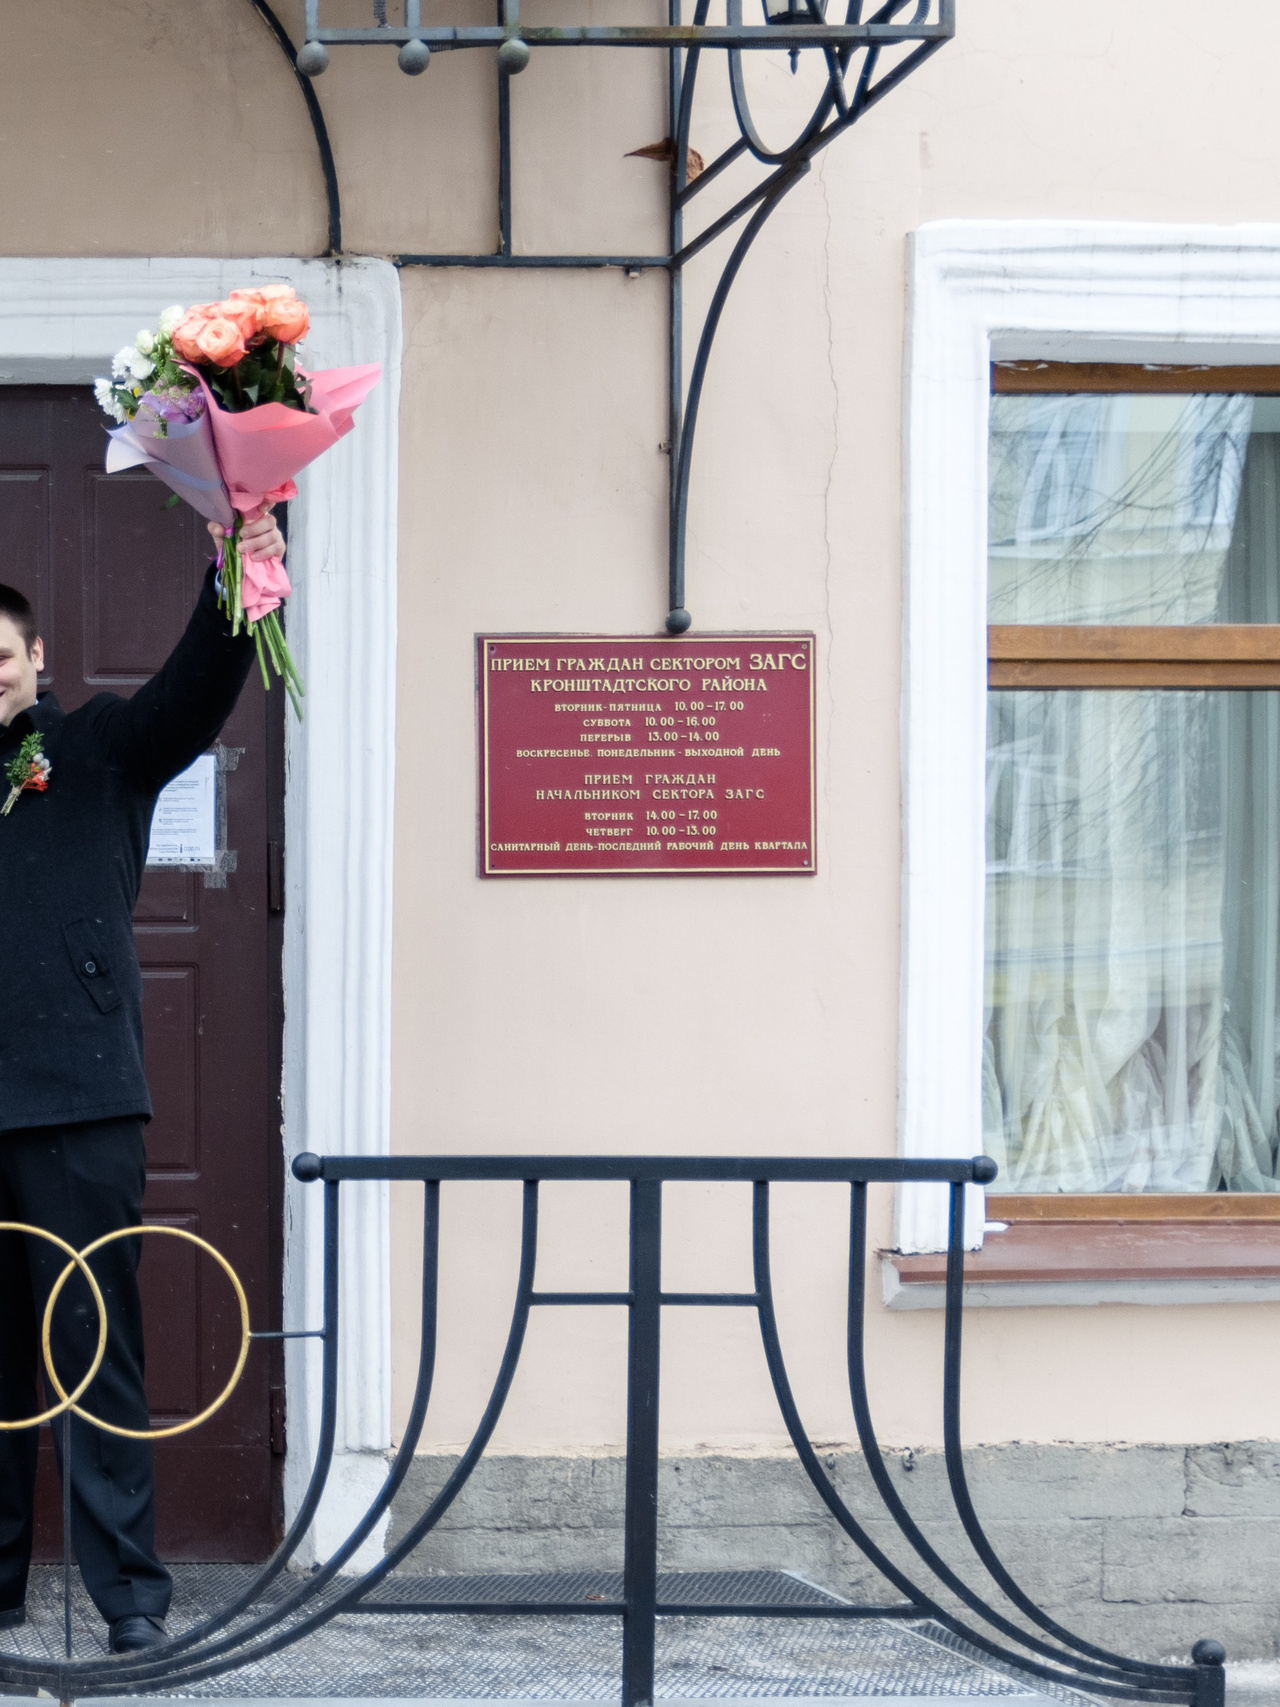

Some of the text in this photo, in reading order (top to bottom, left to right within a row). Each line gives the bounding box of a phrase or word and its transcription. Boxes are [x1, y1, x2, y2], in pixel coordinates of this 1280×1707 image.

[491, 654, 805, 672] ПРИЕМ ГРАЖДАН СЕКТОРОМ ЗАГС
[530, 676, 767, 694] КРОНШТАДТСКОГО РАЙОНА
[582, 719, 631, 727] СУББОТА
[580, 734, 631, 742] ПЕРЕРЫВ
[751, 748, 780, 758] ДЕНЬ
[584, 774, 715, 785] ПРИЕМ ГРАЖДАН
[536, 789, 764, 800] НАЧАЛЬНИКОМ СЕКТОРА ЗАГС
[584, 813, 633, 821] ВТОРНИК
[585, 828, 632, 837] ЧЕТВЕРГ
[490, 842, 560, 851] САНИТАРНЫЙ
[666, 841, 713, 851] РАБОЧИЙ
[720, 842, 749, 851] ДЕНЬ
[754, 842, 806, 850] КВАРТАЛА
